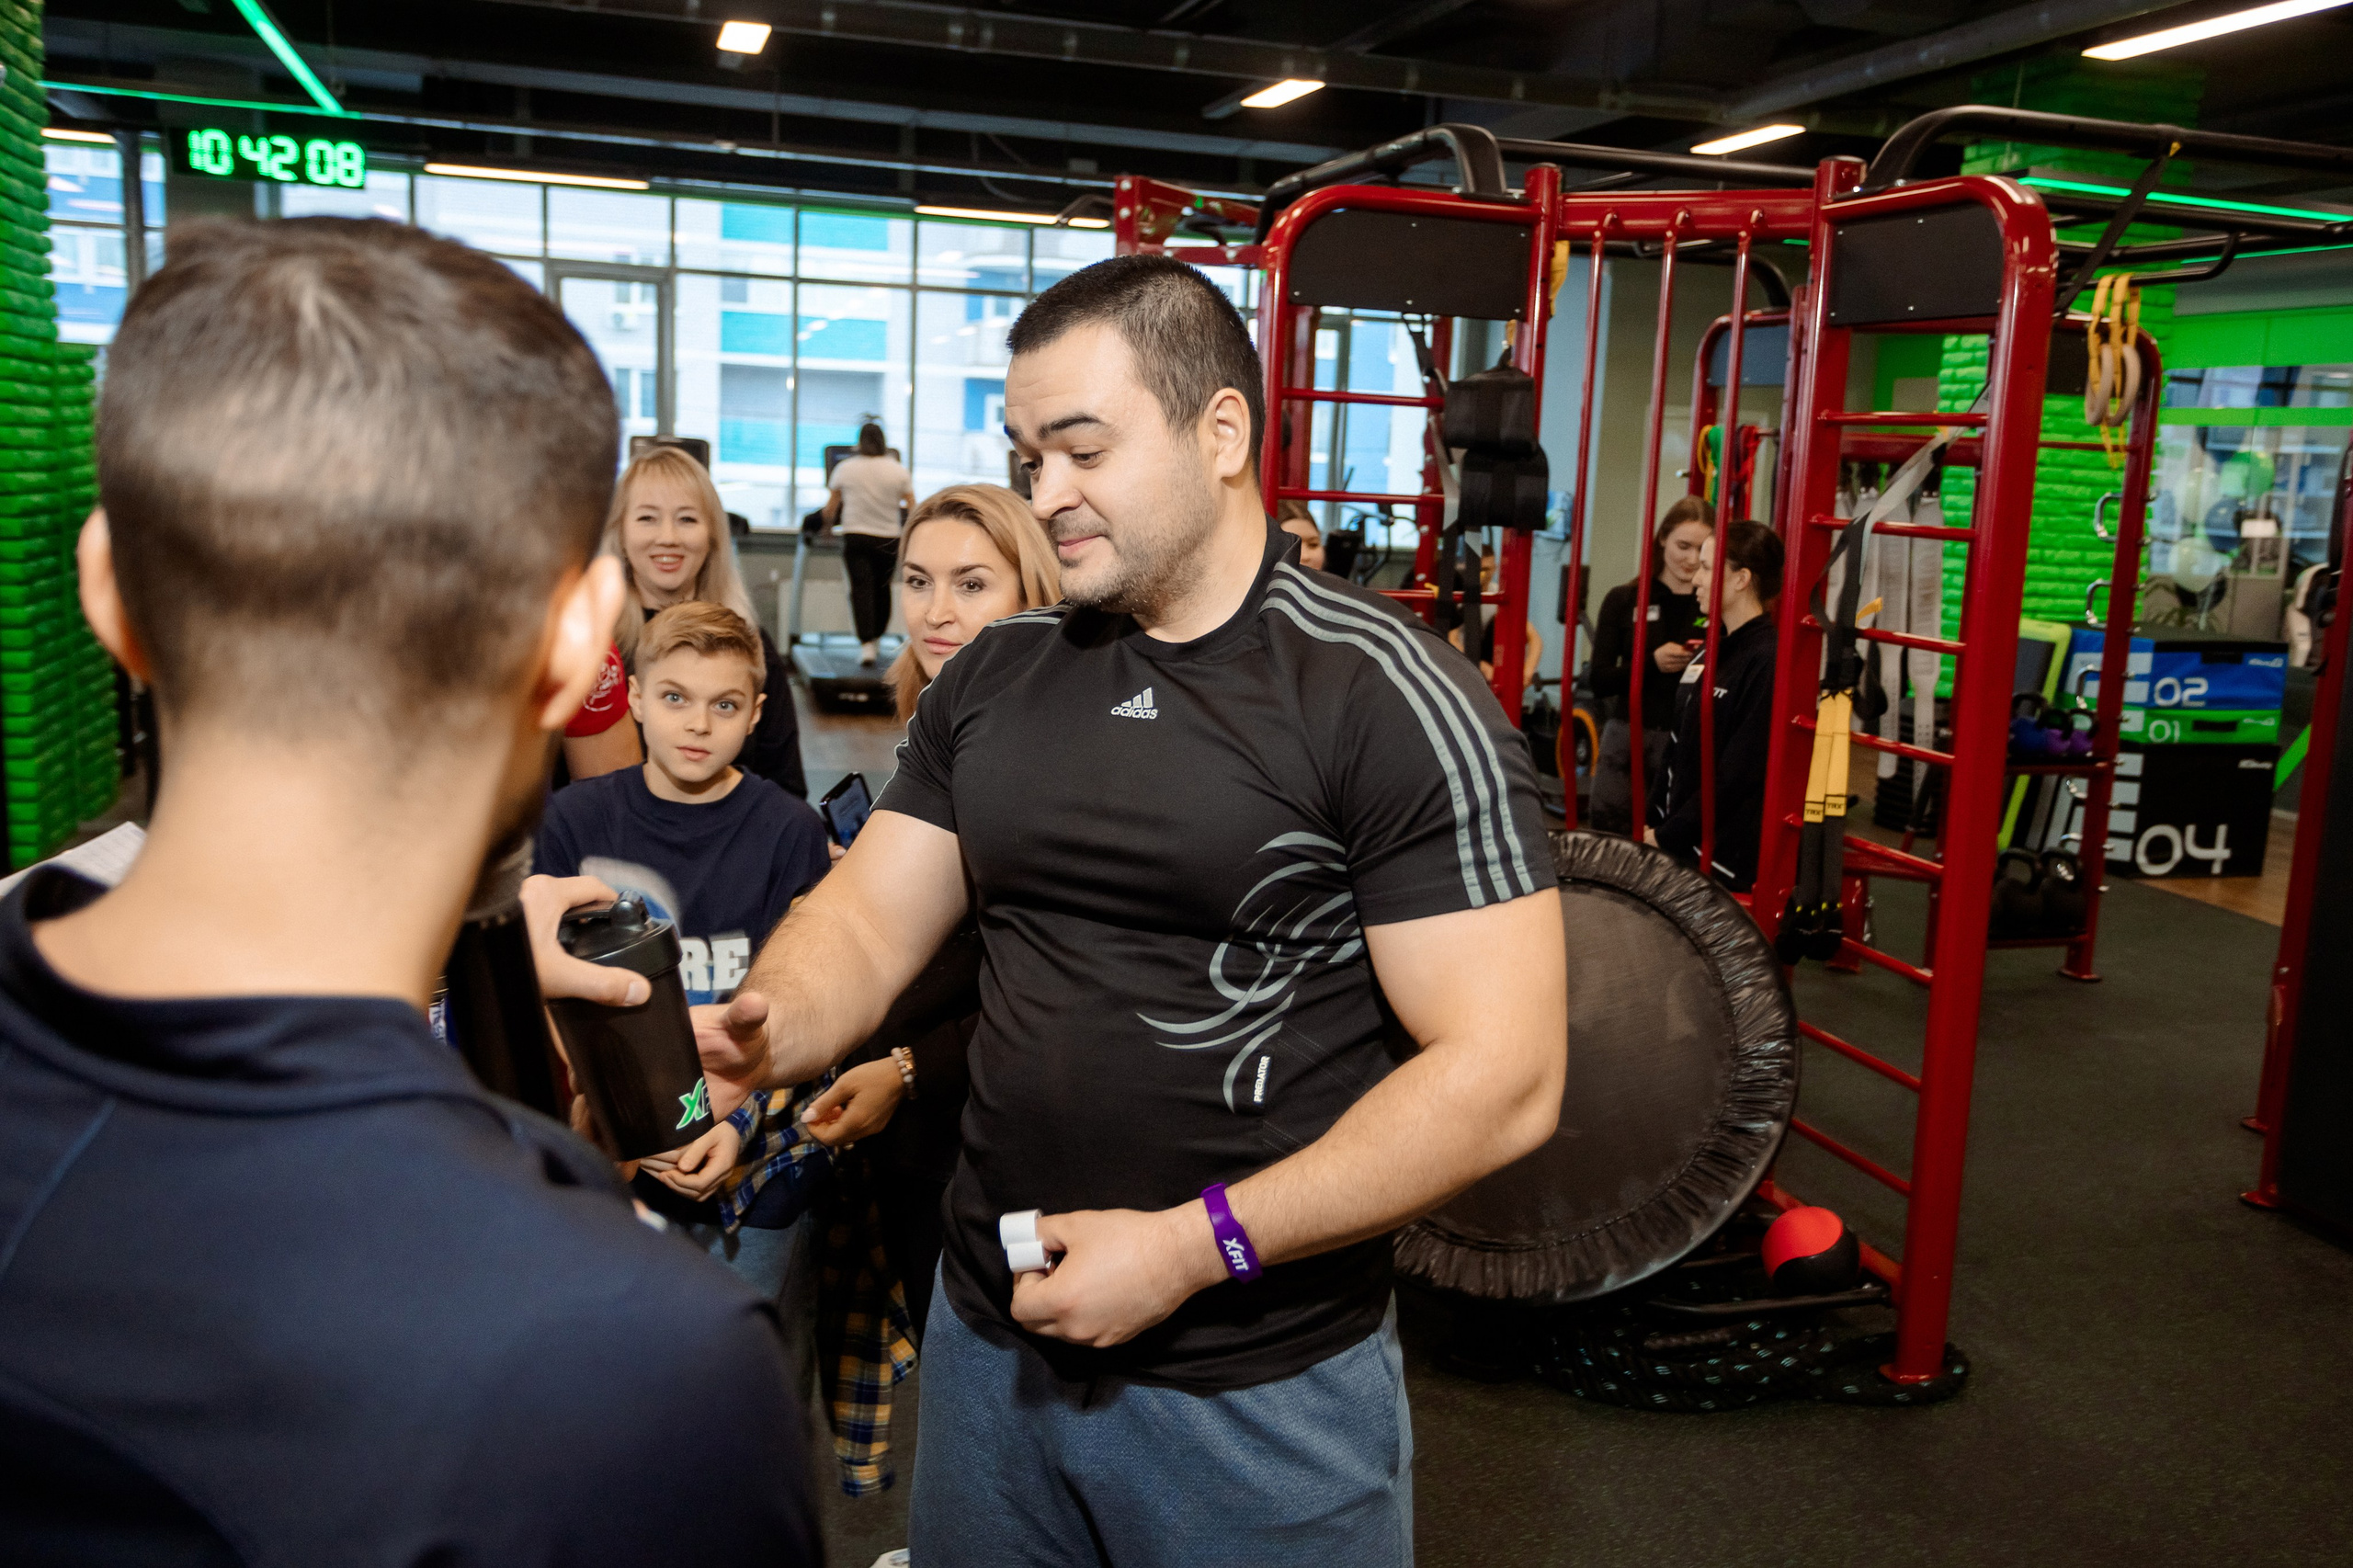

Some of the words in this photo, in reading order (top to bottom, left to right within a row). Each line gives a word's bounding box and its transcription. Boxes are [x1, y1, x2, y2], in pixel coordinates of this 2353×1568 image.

[188, 129, 234, 176] 10
[238, 135, 300, 181] 42
[305, 139, 365, 187] 08
[2154, 676, 2209, 707] 02
[1110, 706, 1158, 720] adidas
[2148, 720, 2181, 743] 01
[2135, 824, 2232, 875] 04
[1253, 1055, 1271, 1103] PREDATOR
[1222, 1237, 1249, 1271] XFIT
